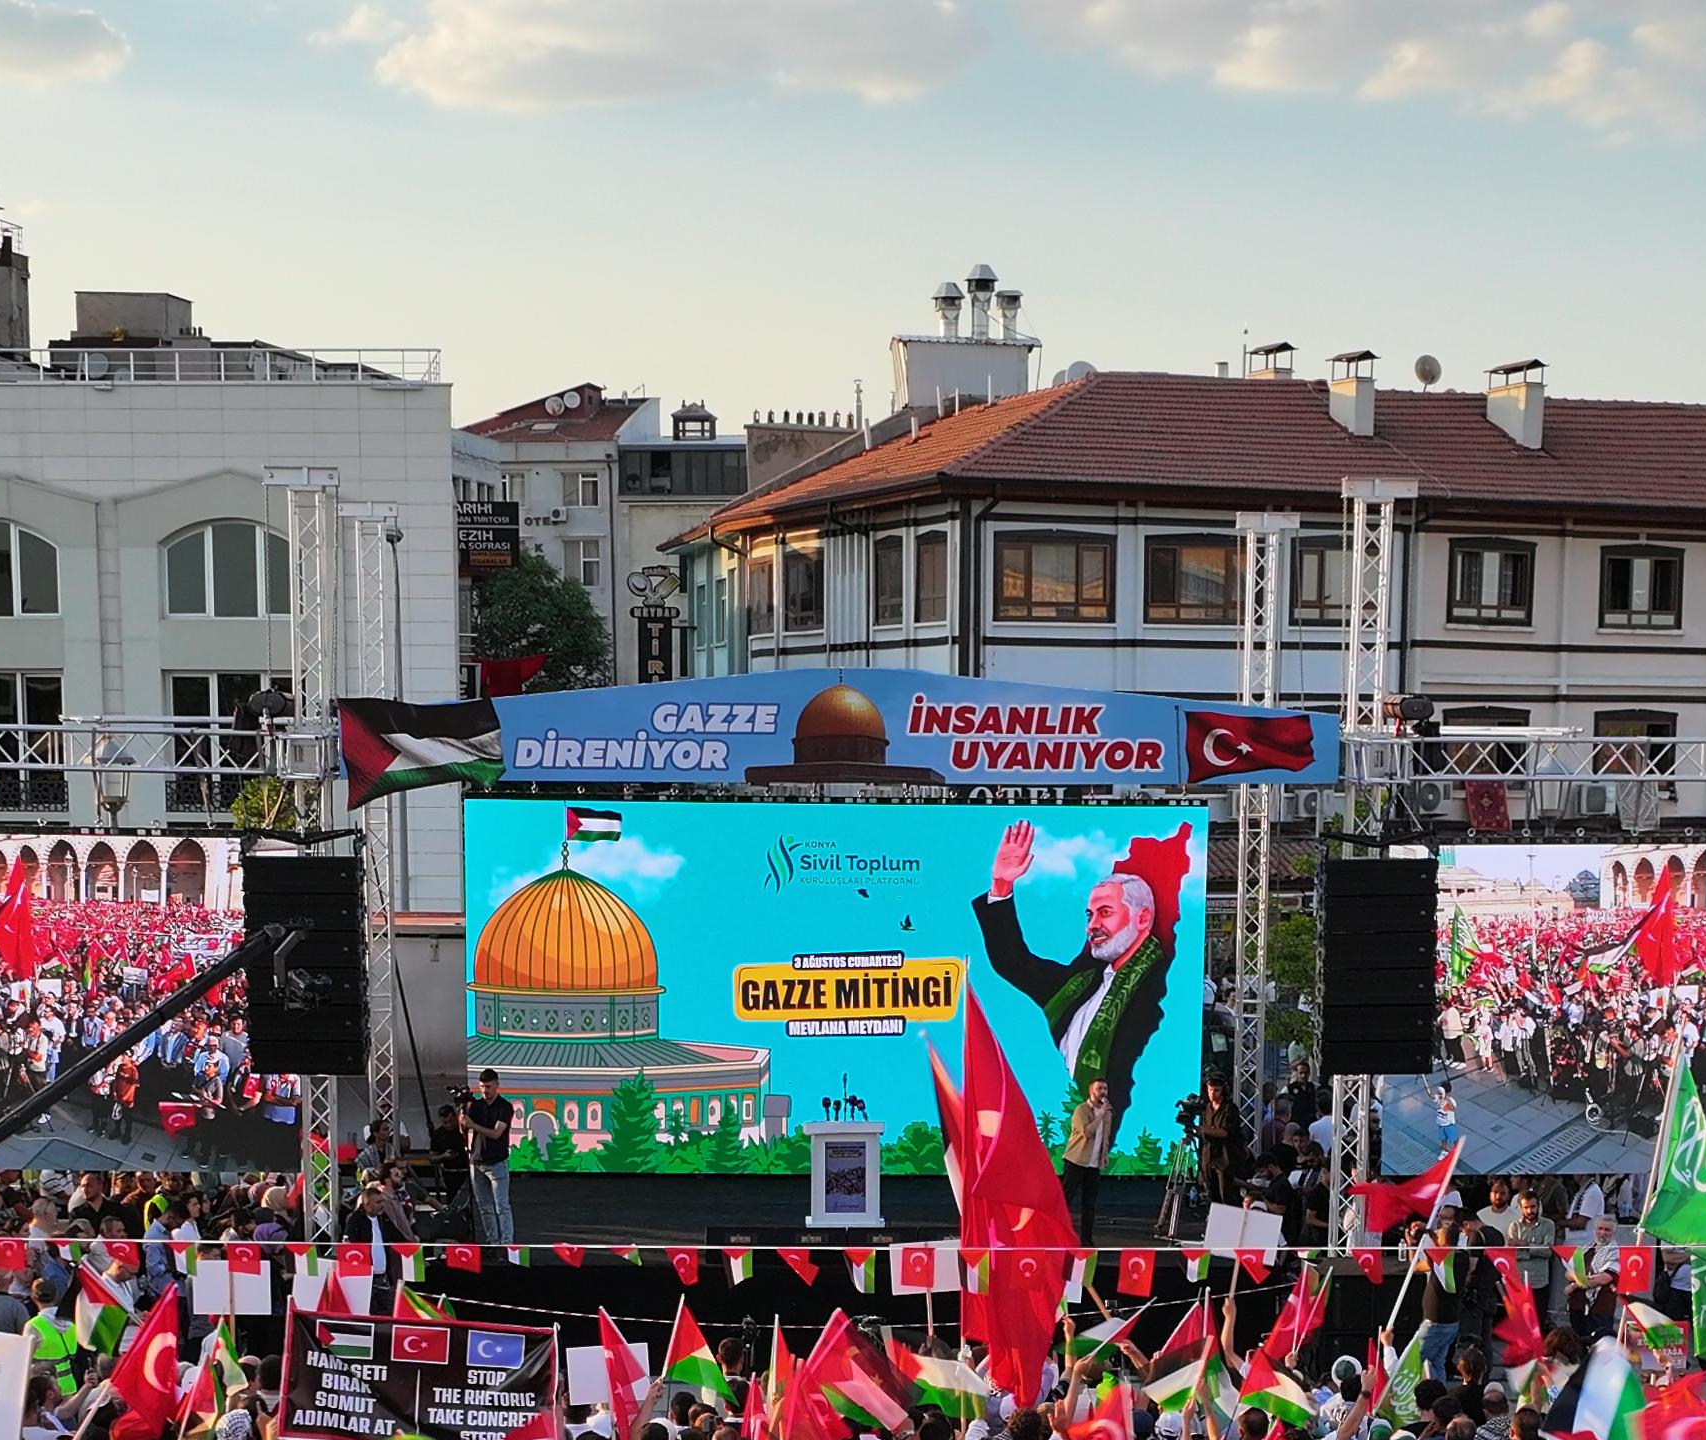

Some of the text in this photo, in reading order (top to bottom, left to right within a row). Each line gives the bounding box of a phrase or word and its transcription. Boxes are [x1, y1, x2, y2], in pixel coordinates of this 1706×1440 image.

[524, 517, 551, 526] OTE
[651, 703, 779, 734] GAZZE
[907, 693, 1104, 736] İNSANLIK
[514, 728, 728, 769] DİRENİYOR
[951, 739, 1164, 771] UYANIYOR
[805, 841, 836, 849] KONYA
[800, 854, 920, 875] Sivil Toplum
[800, 877, 920, 885] KURULUŞLARI PLATFORMU
[793, 954, 902, 969] 3 AĞUSTOS CUMARTESİ
[741, 970, 952, 1012] GAZZE MİTİNGİ
[788, 1019, 903, 1036] MEVLANA MEYDANI
[321, 1372, 372, 1394] BIRAK
[467, 1369, 506, 1387] STOP
[315, 1391, 377, 1415] SOMUT
[433, 1387, 536, 1408] THE RHETORIC
[293, 1409, 396, 1436] ADIMLAR AT
[427, 1407, 464, 1427] TAKE
